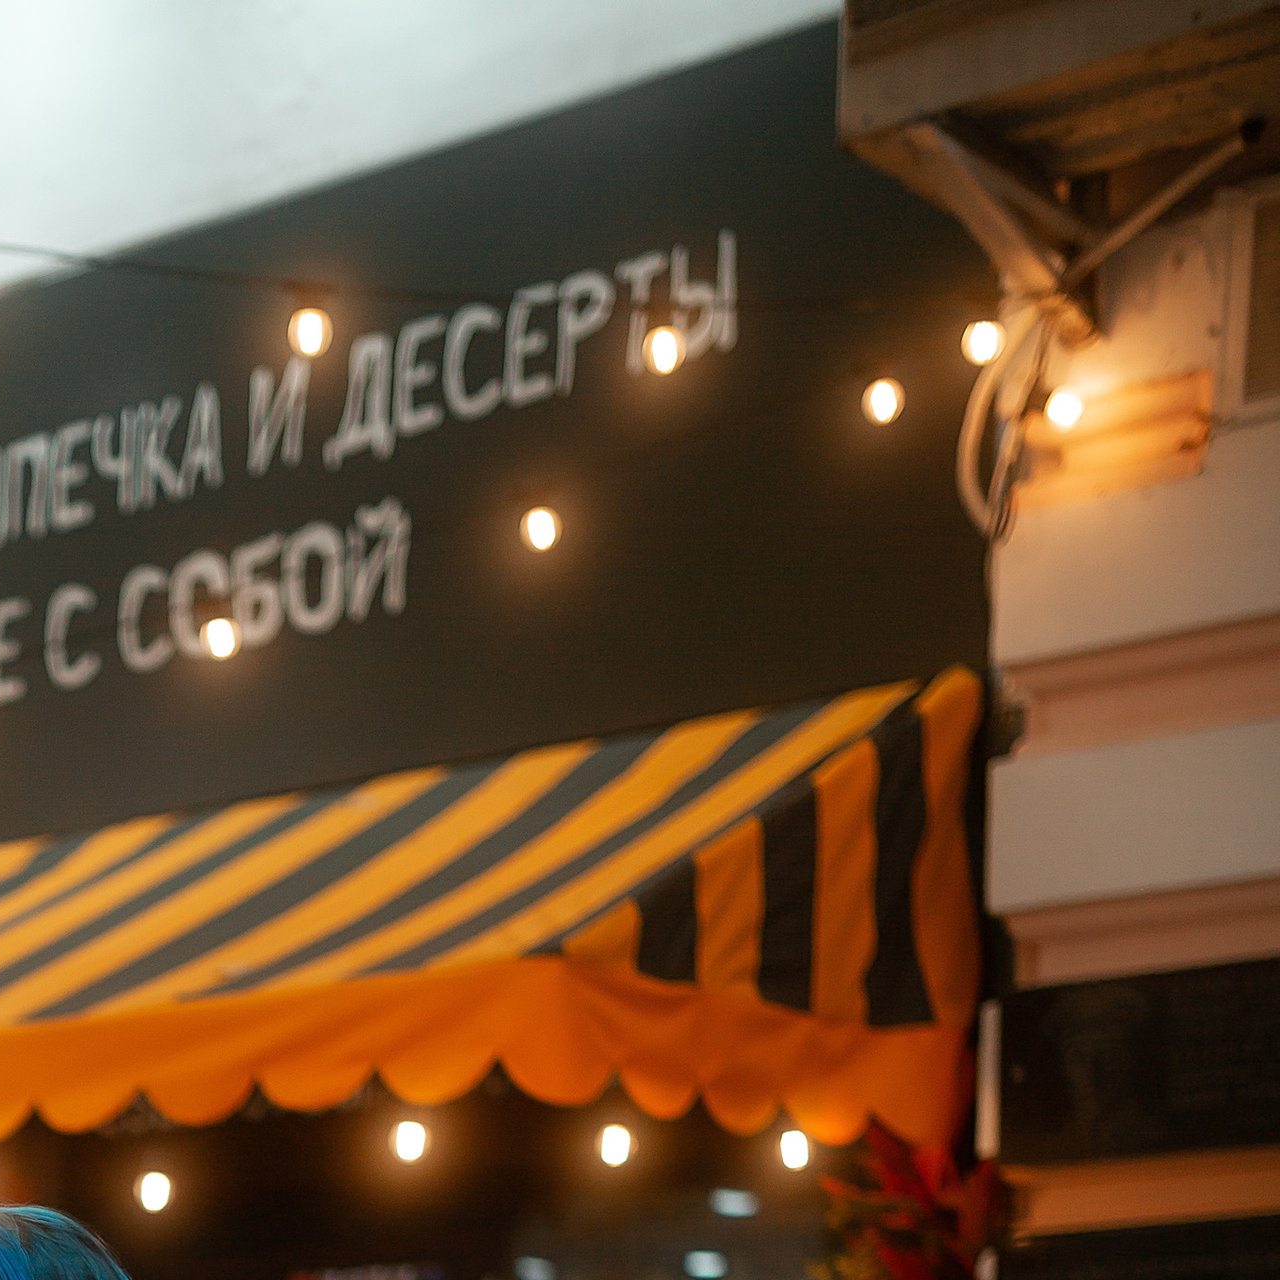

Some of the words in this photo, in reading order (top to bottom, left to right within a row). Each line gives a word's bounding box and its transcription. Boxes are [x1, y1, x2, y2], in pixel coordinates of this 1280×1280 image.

[245, 353, 312, 478] И
[322, 228, 739, 472] ДЕСЕРТЫ
[43, 582, 102, 692] С
[117, 495, 413, 676] СОБОЙ
